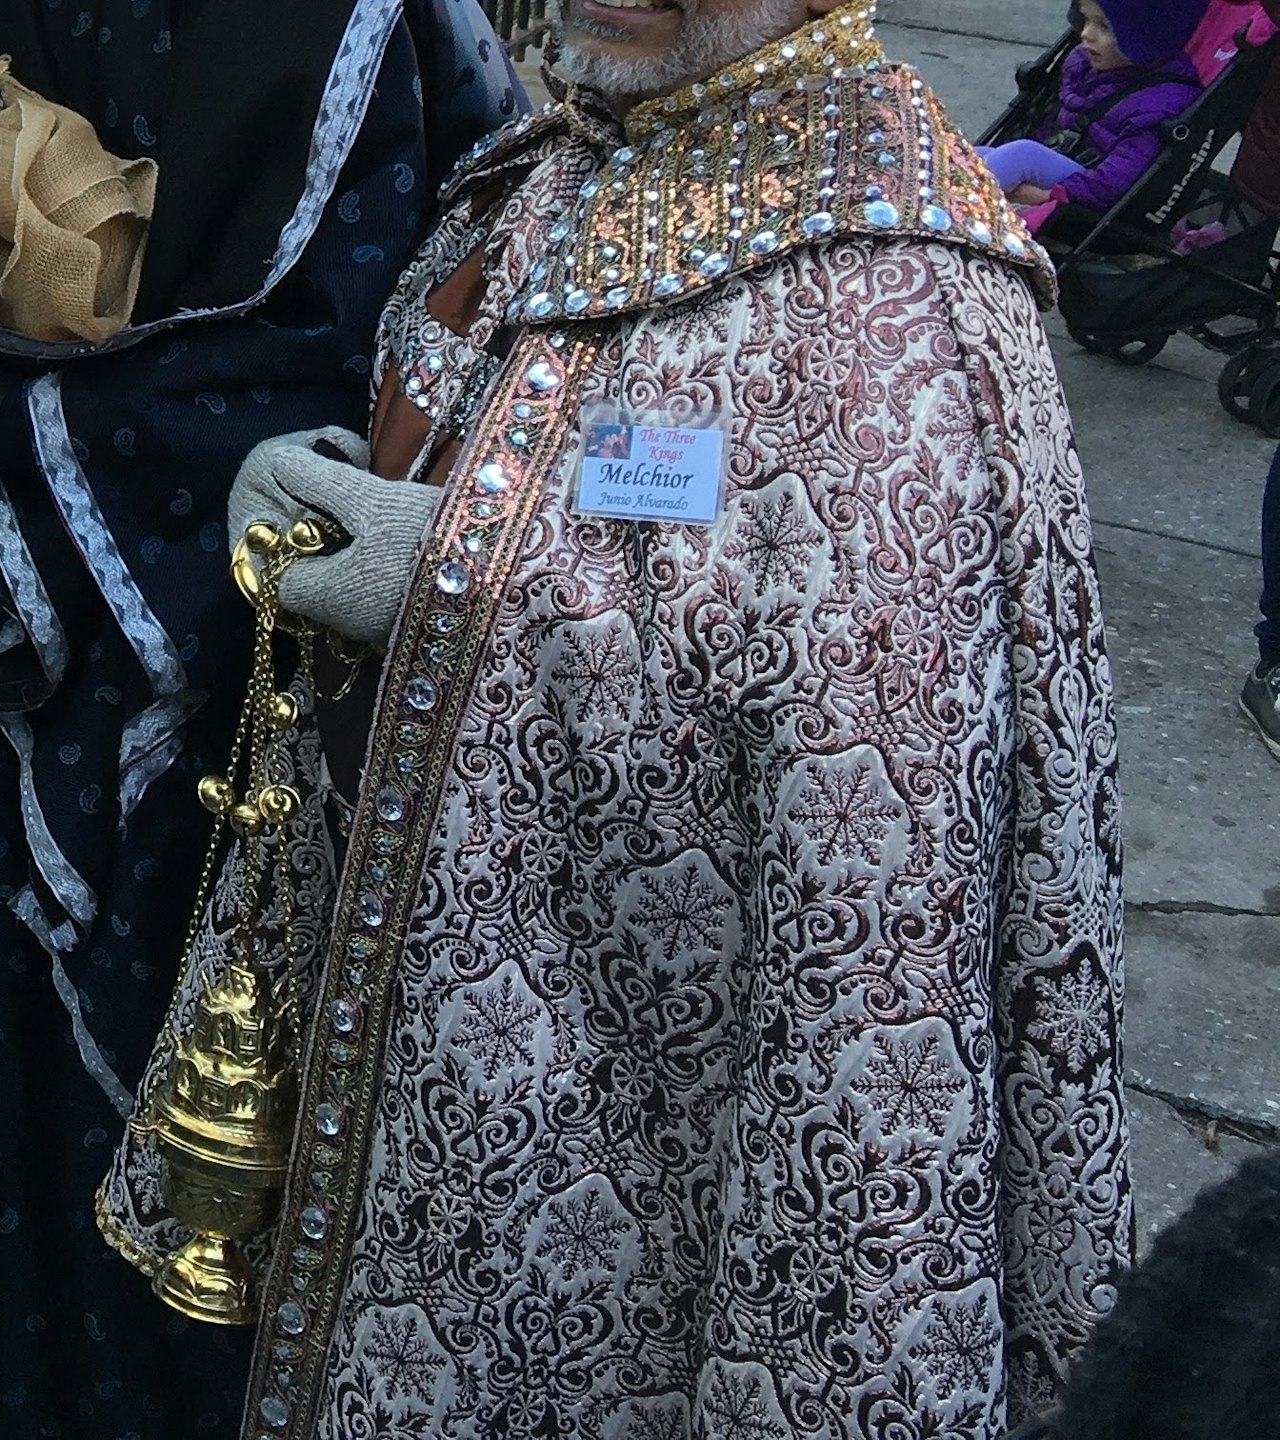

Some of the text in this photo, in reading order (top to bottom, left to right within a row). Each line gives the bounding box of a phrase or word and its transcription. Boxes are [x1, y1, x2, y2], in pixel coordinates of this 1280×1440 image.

[641, 428, 696, 445] The Three
[648, 446, 685, 464] Kings
[598, 462, 694, 489] Melchior
[597, 491, 689, 511] Junio Alvarado
